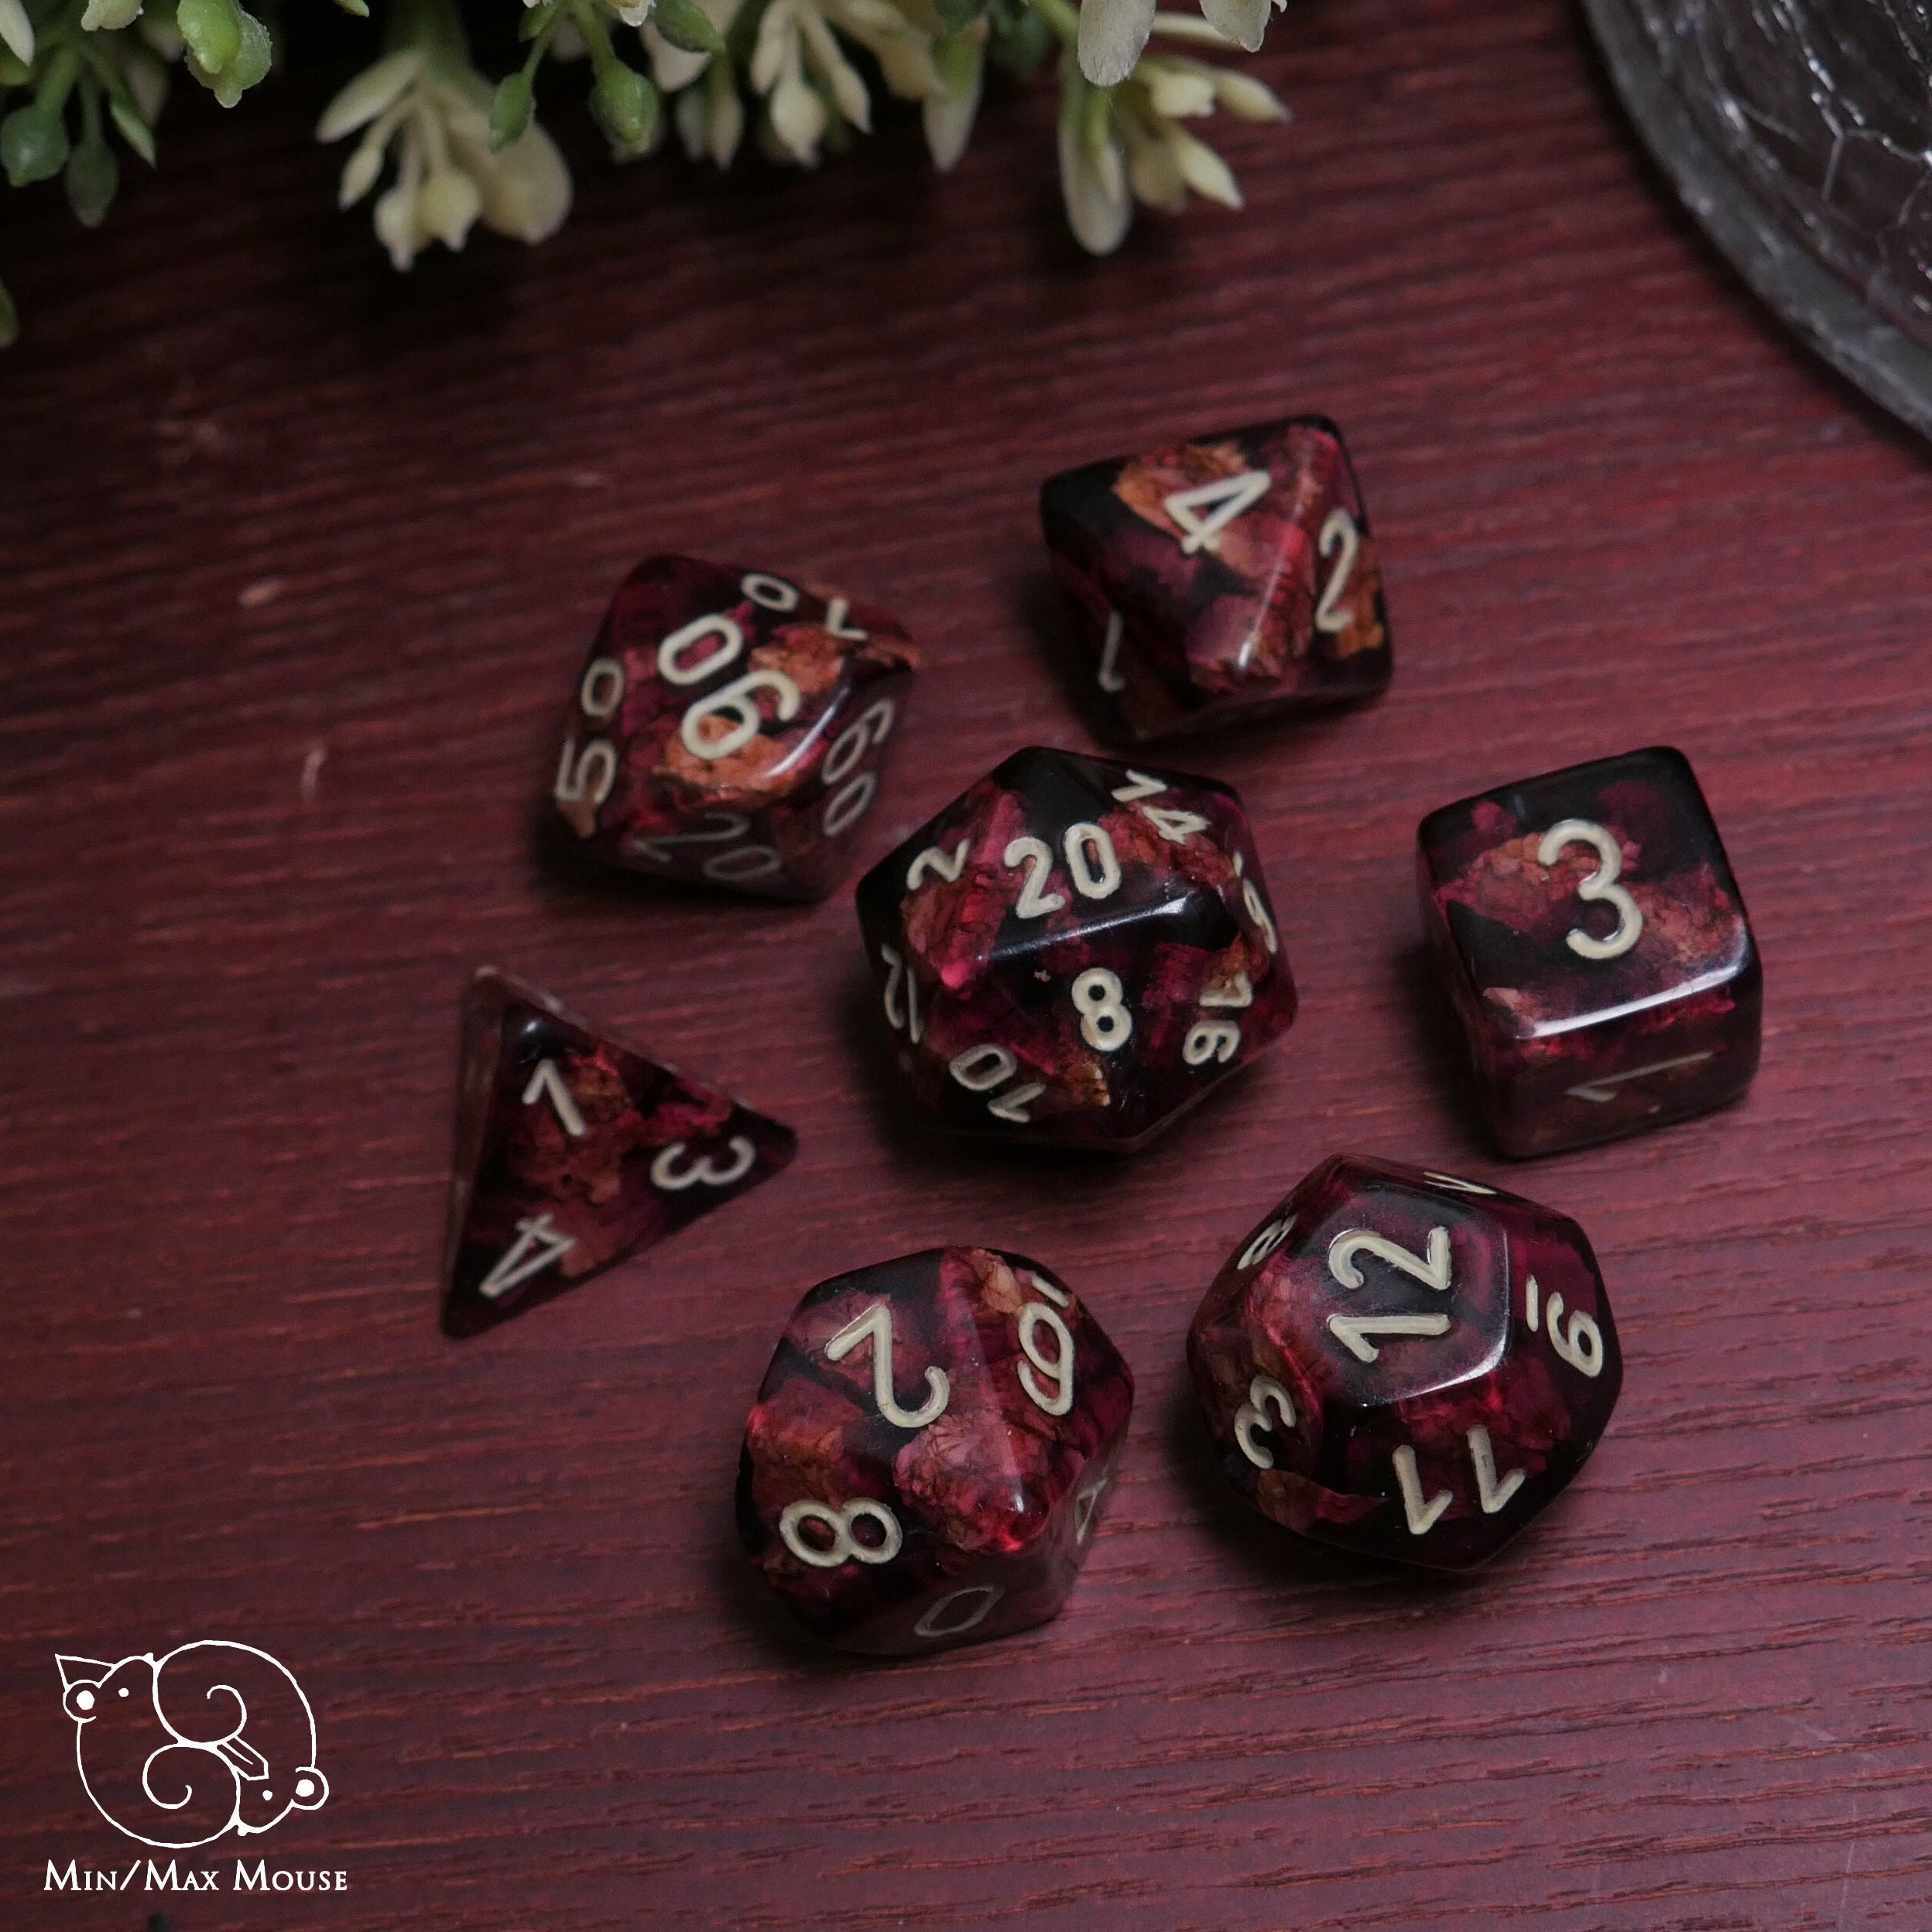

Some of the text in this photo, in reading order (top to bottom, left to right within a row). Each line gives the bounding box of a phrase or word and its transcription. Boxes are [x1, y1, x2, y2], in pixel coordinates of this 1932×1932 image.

[1164, 468, 1273, 556] 4
[1316, 507, 1359, 634] 2
[553, 657, 624, 806] 50
[1112, 769, 1211, 844] 14
[907, 839, 969, 891] 2
[1004, 822, 1122, 919] 20
[1537, 818, 1643, 960] 3
[1071, 968, 1132, 1052] 8
[1183, 971, 1253, 1066] 16
[521, 1058, 584, 1137] 1
[949, 1044, 1046, 1123] 10
[649, 1135, 757, 1190] 3
[478, 1212, 578, 1298] 4
[1327, 1226, 1451, 1364] 12
[825, 1303, 950, 1428] 2
[1234, 1374, 1296, 1469] 3
[1392, 1424, 1526, 1535] 11
[779, 1496, 903, 1567] 8
